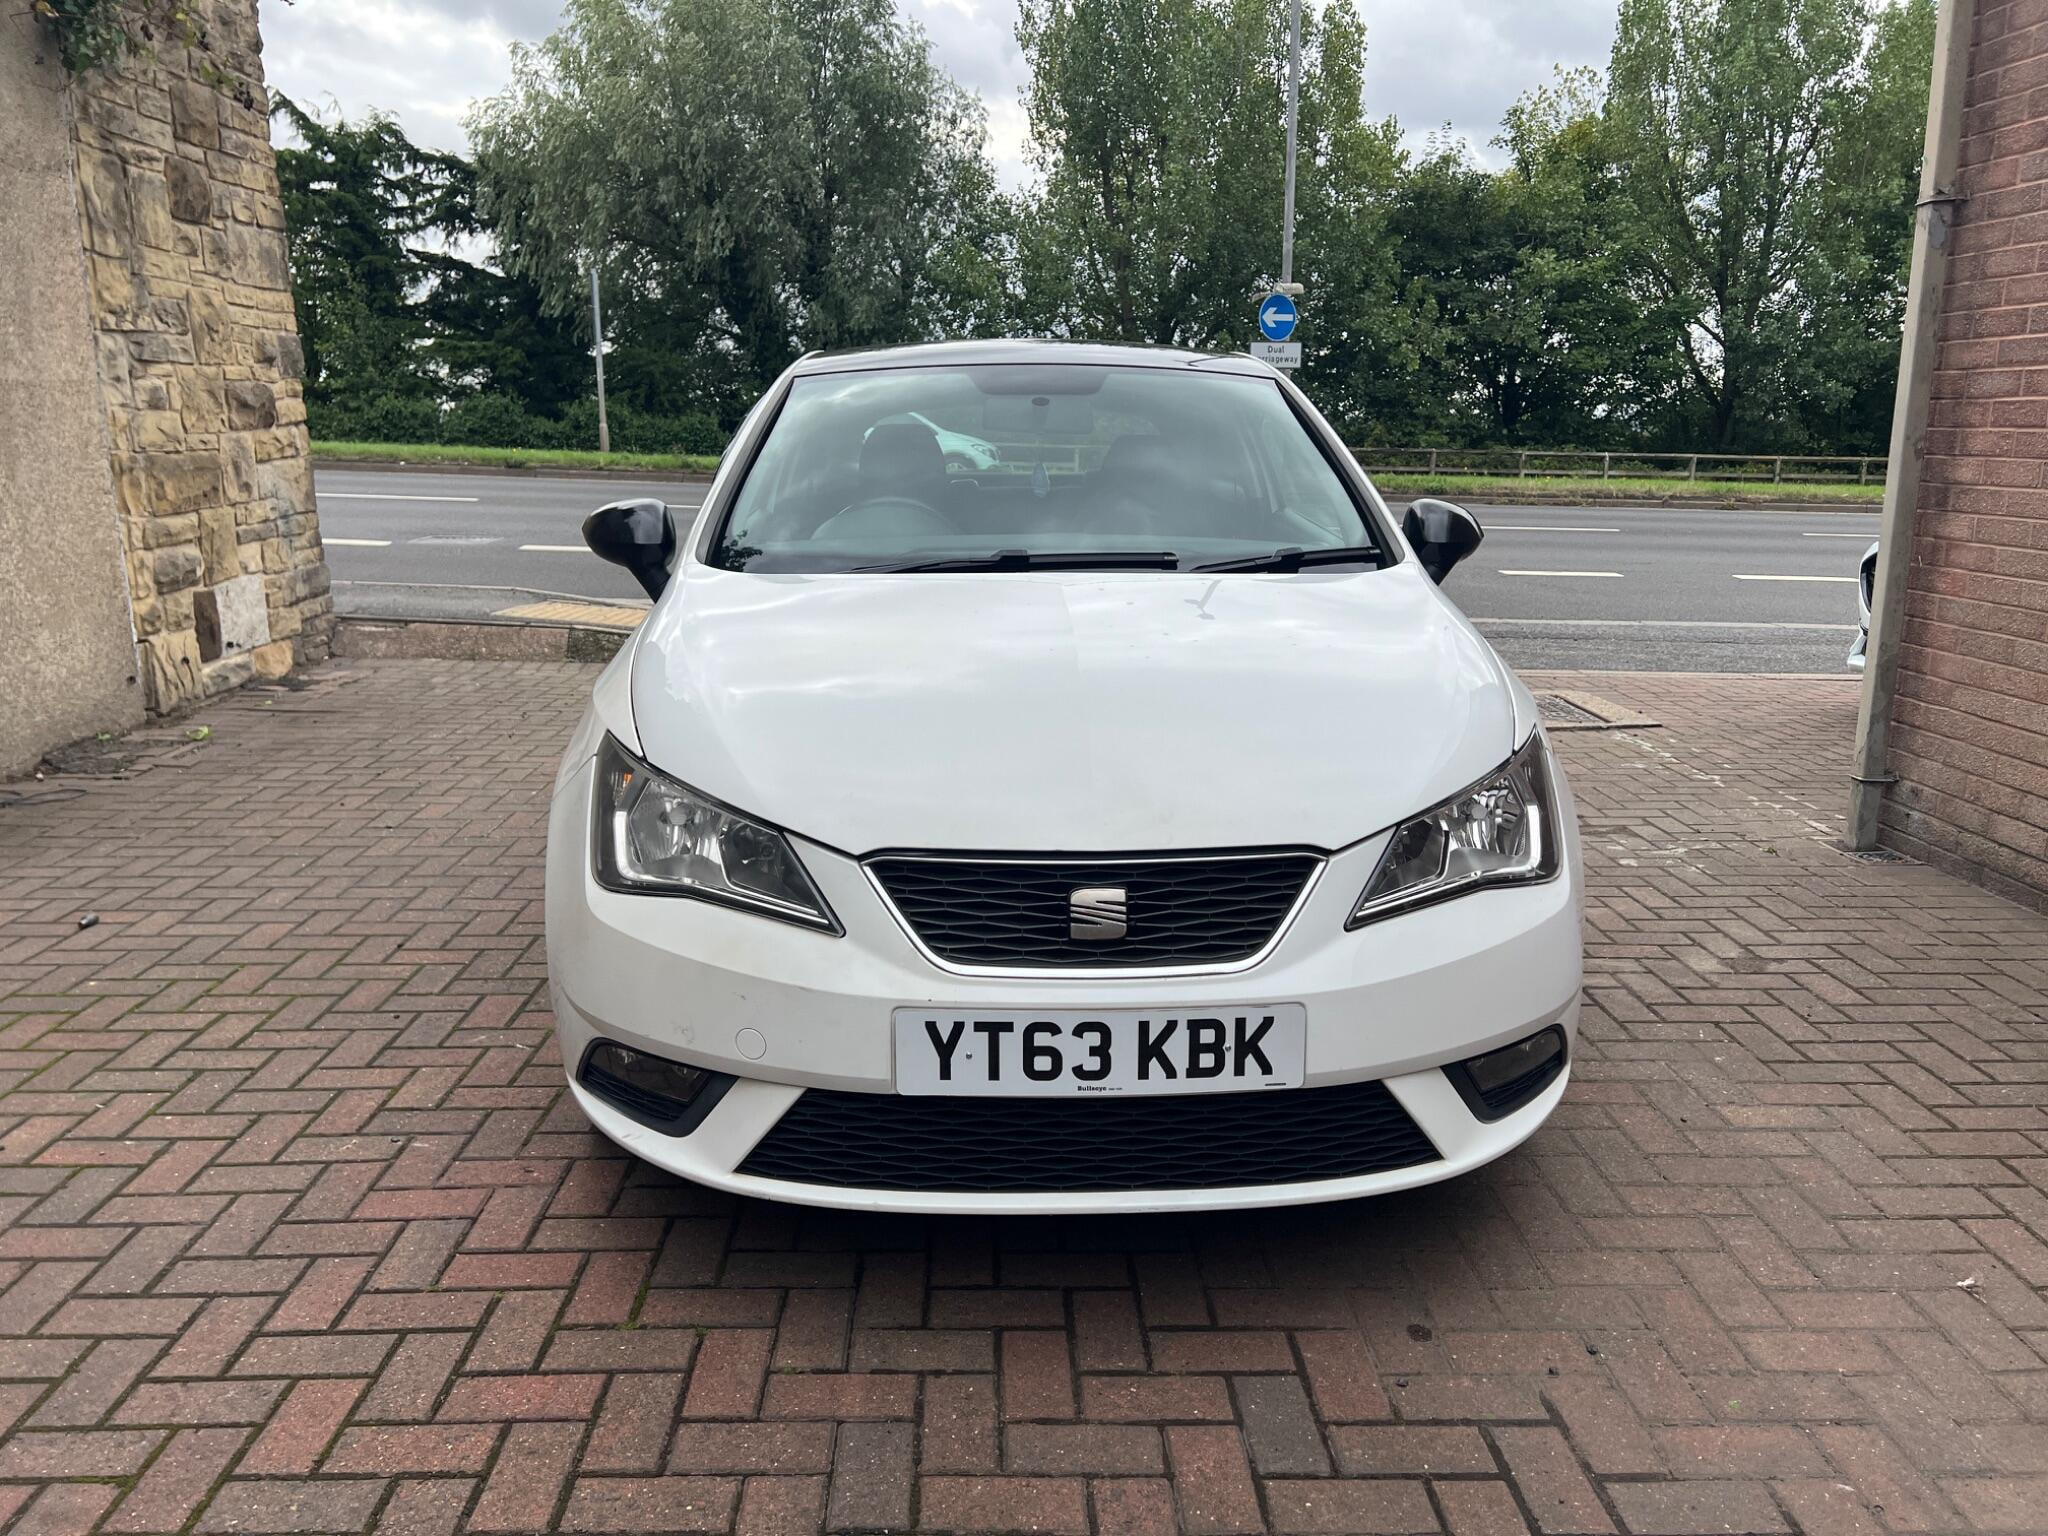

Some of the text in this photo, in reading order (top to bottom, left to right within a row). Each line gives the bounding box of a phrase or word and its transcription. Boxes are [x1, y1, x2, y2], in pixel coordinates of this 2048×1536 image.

[1267, 345, 1285, 353] Dual
[1258, 355, 1298, 364] rriageway
[924, 1016, 1275, 1081] YT63 KBK
